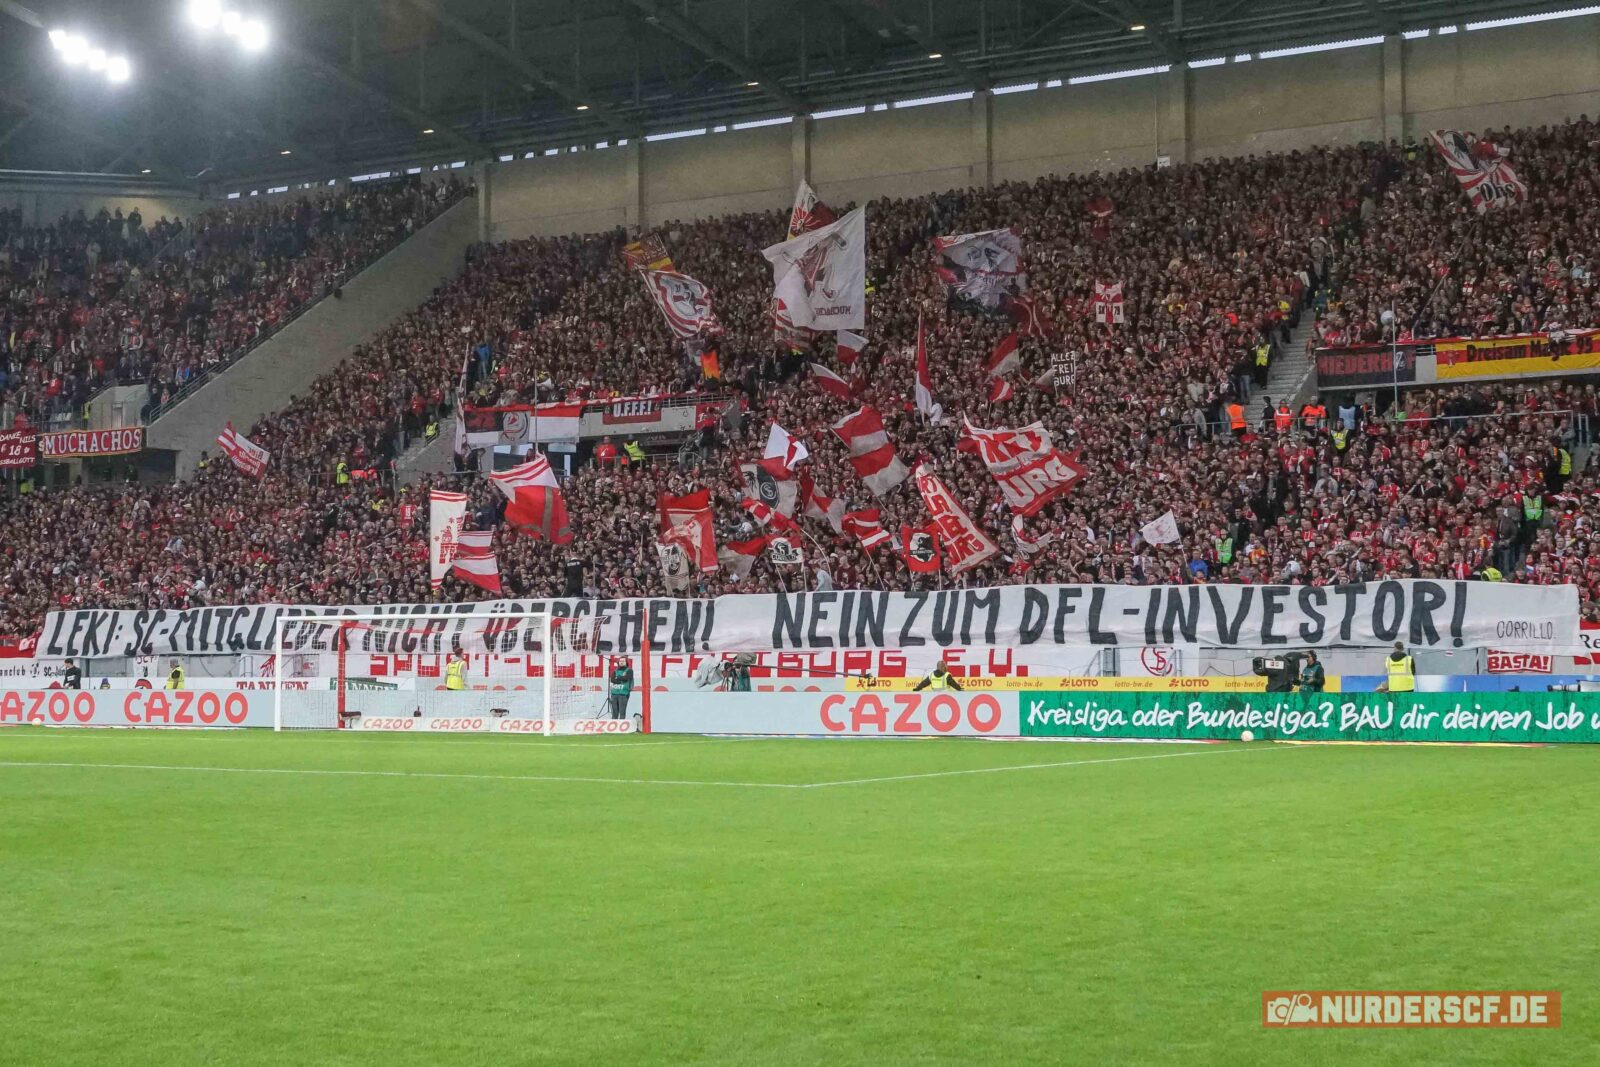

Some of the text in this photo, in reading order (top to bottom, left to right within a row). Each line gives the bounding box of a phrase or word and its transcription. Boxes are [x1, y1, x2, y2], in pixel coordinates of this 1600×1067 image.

[1050, 351, 1075, 362] ALLEZ
[1053, 363, 1074, 374] FREI
[44, 429, 141, 455] MUCHACHOS
[8, 445, 21, 456] 18
[47, 580, 1468, 656] LEKI: SC-MITGLIEDER NICHT ÜBERGEHEN! NEIN ZUM DFL-INVESTOR!
[1487, 655, 1550, 670] BASTA!
[966, 679, 993, 687] LOTTO
[1071, 679, 1099, 687] LOTTO
[1181, 679, 1209, 687] LOTTO
[0, 691, 96, 722] AZOO
[123, 691, 249, 724] CAZOO
[819, 693, 1002, 733] CAZOO
[1027, 700, 1128, 732] Kreisliga
[1131, 702, 1184, 727] oder
[1186, 702, 1334, 735] Bundesliga?
[1338, 701, 1394, 732] BAU
[1399, 703, 1440, 730] dir
[1442, 703, 1532, 731] deinen
[1534, 701, 1585, 731] Job
[363, 718, 414, 730] CAZOO
[430, 718, 483, 730] CAZOO
[573, 720, 631, 732] CAZOO
